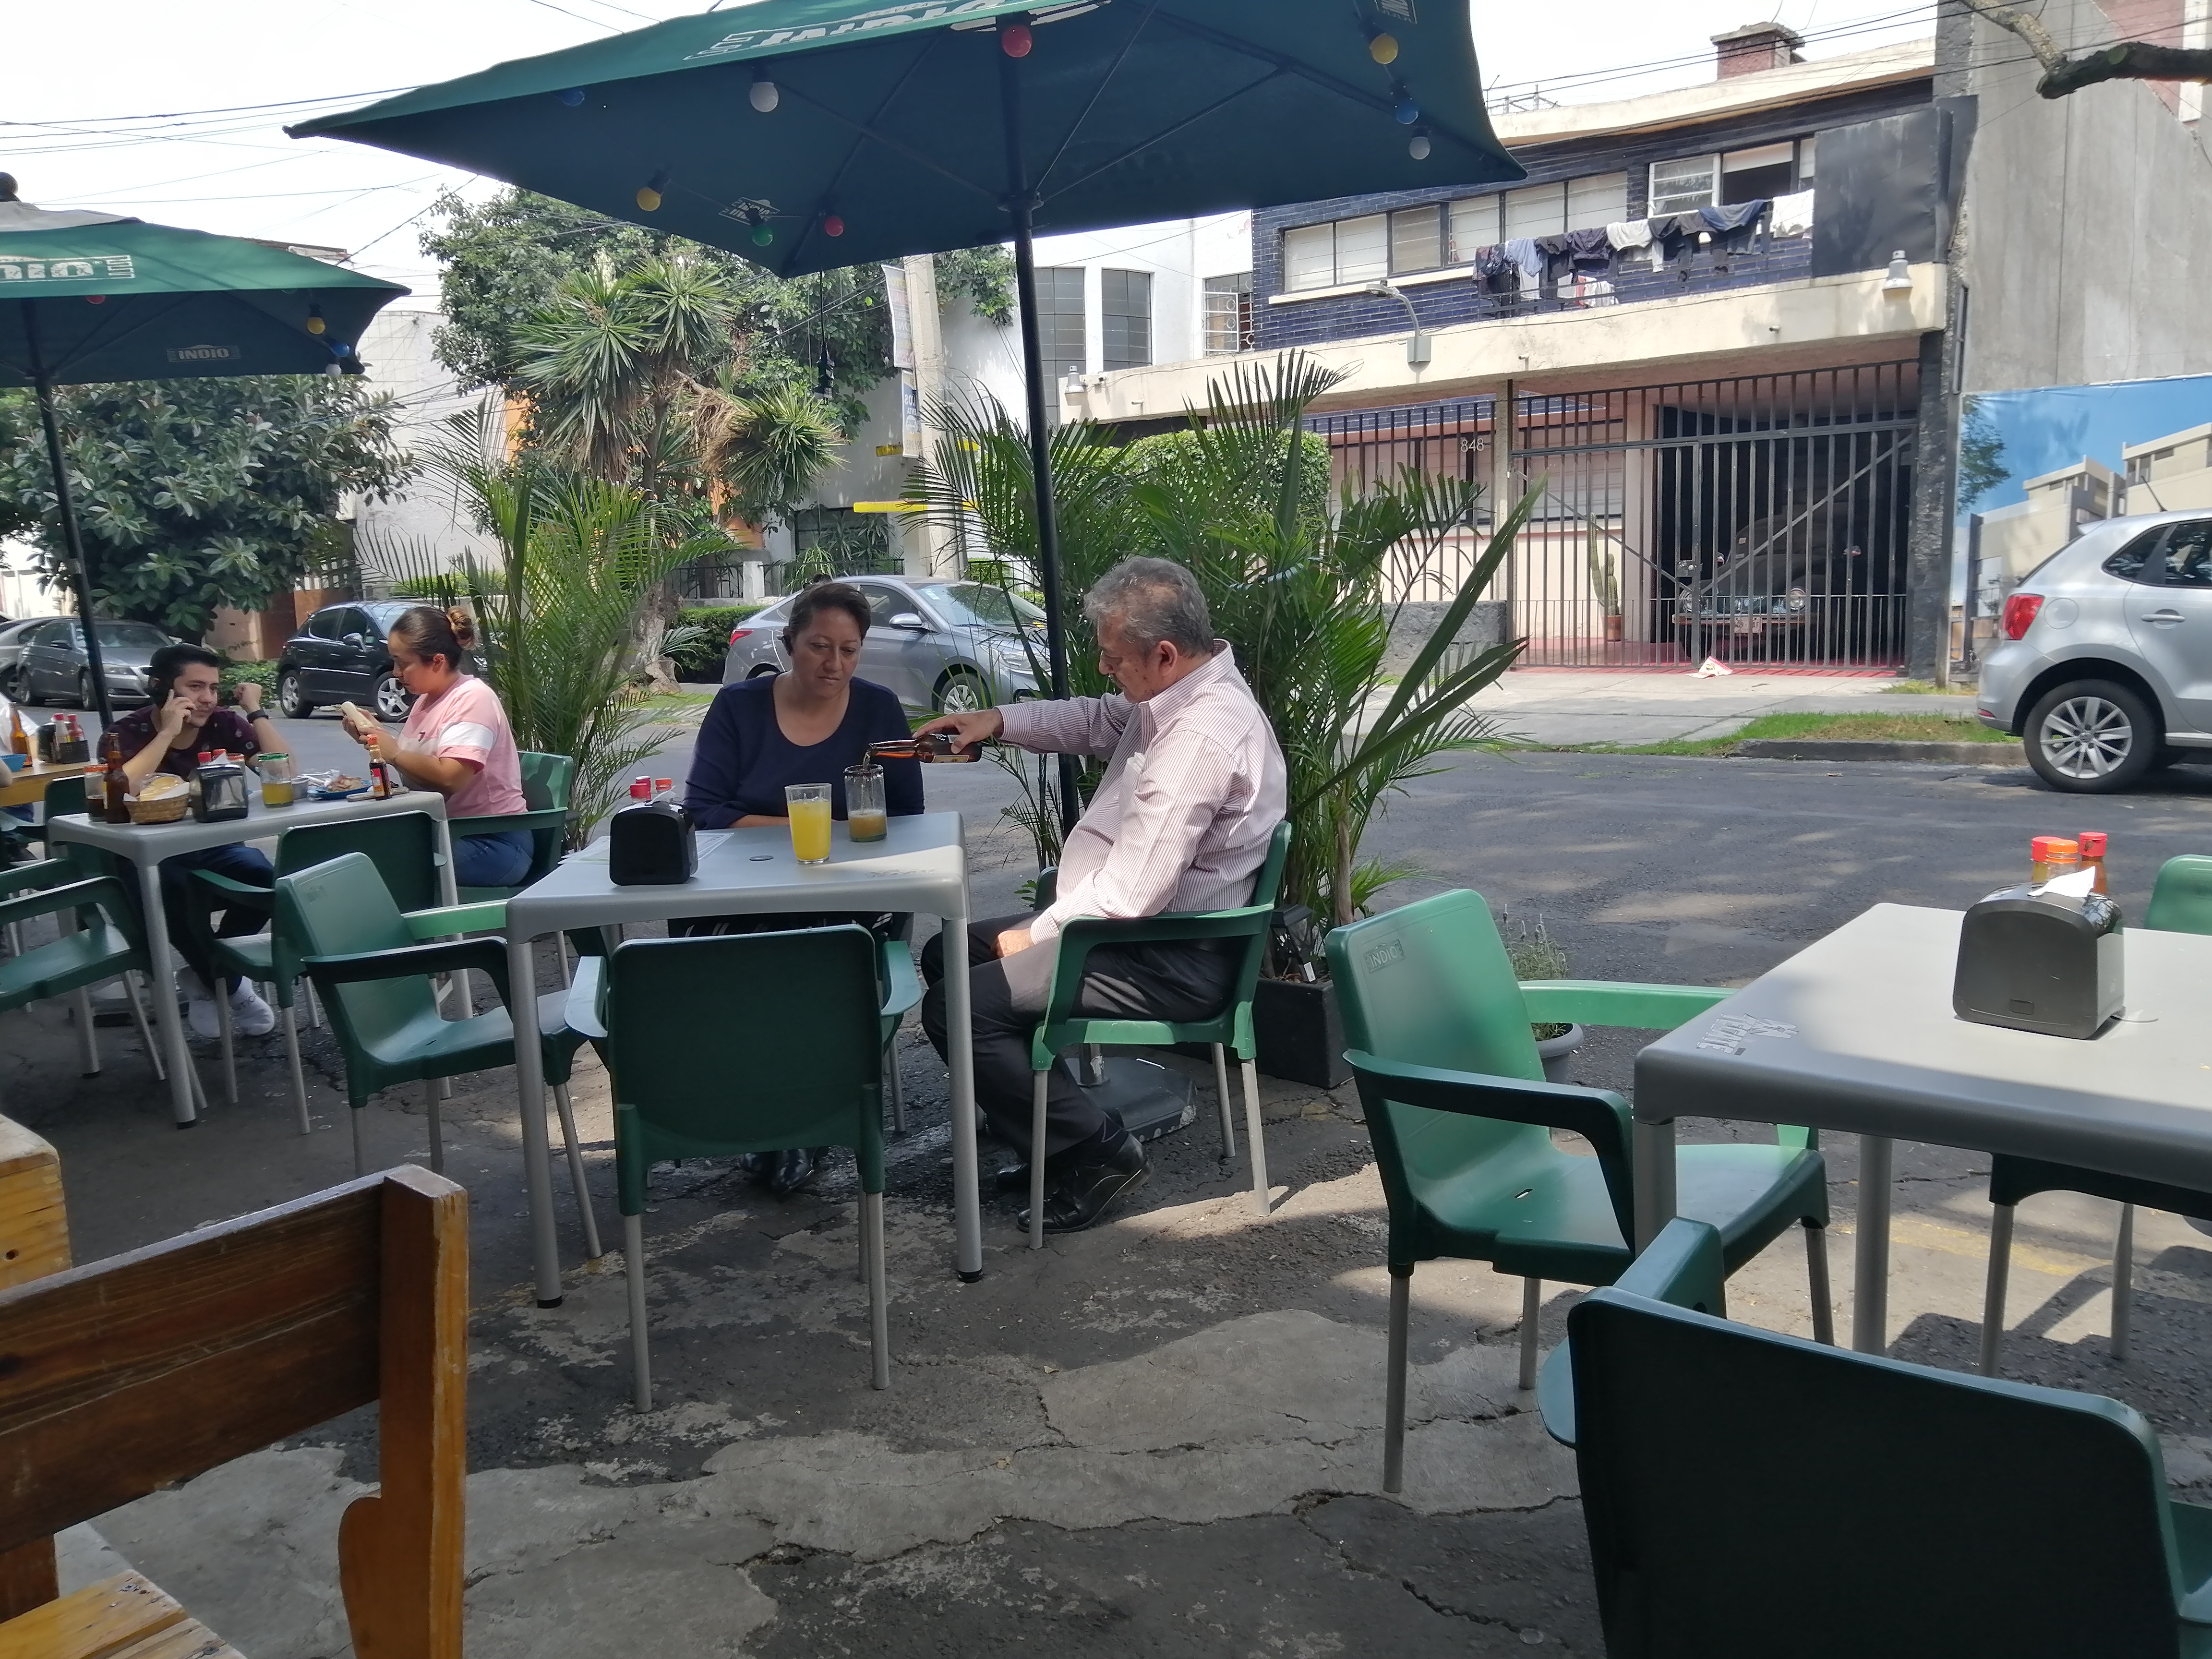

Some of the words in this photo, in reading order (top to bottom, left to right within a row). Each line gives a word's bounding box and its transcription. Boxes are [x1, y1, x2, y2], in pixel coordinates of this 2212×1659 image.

[178, 348, 229, 360] INDIO
[1461, 438, 1485, 452] 848
[1369, 946, 1398, 968] INDIO
